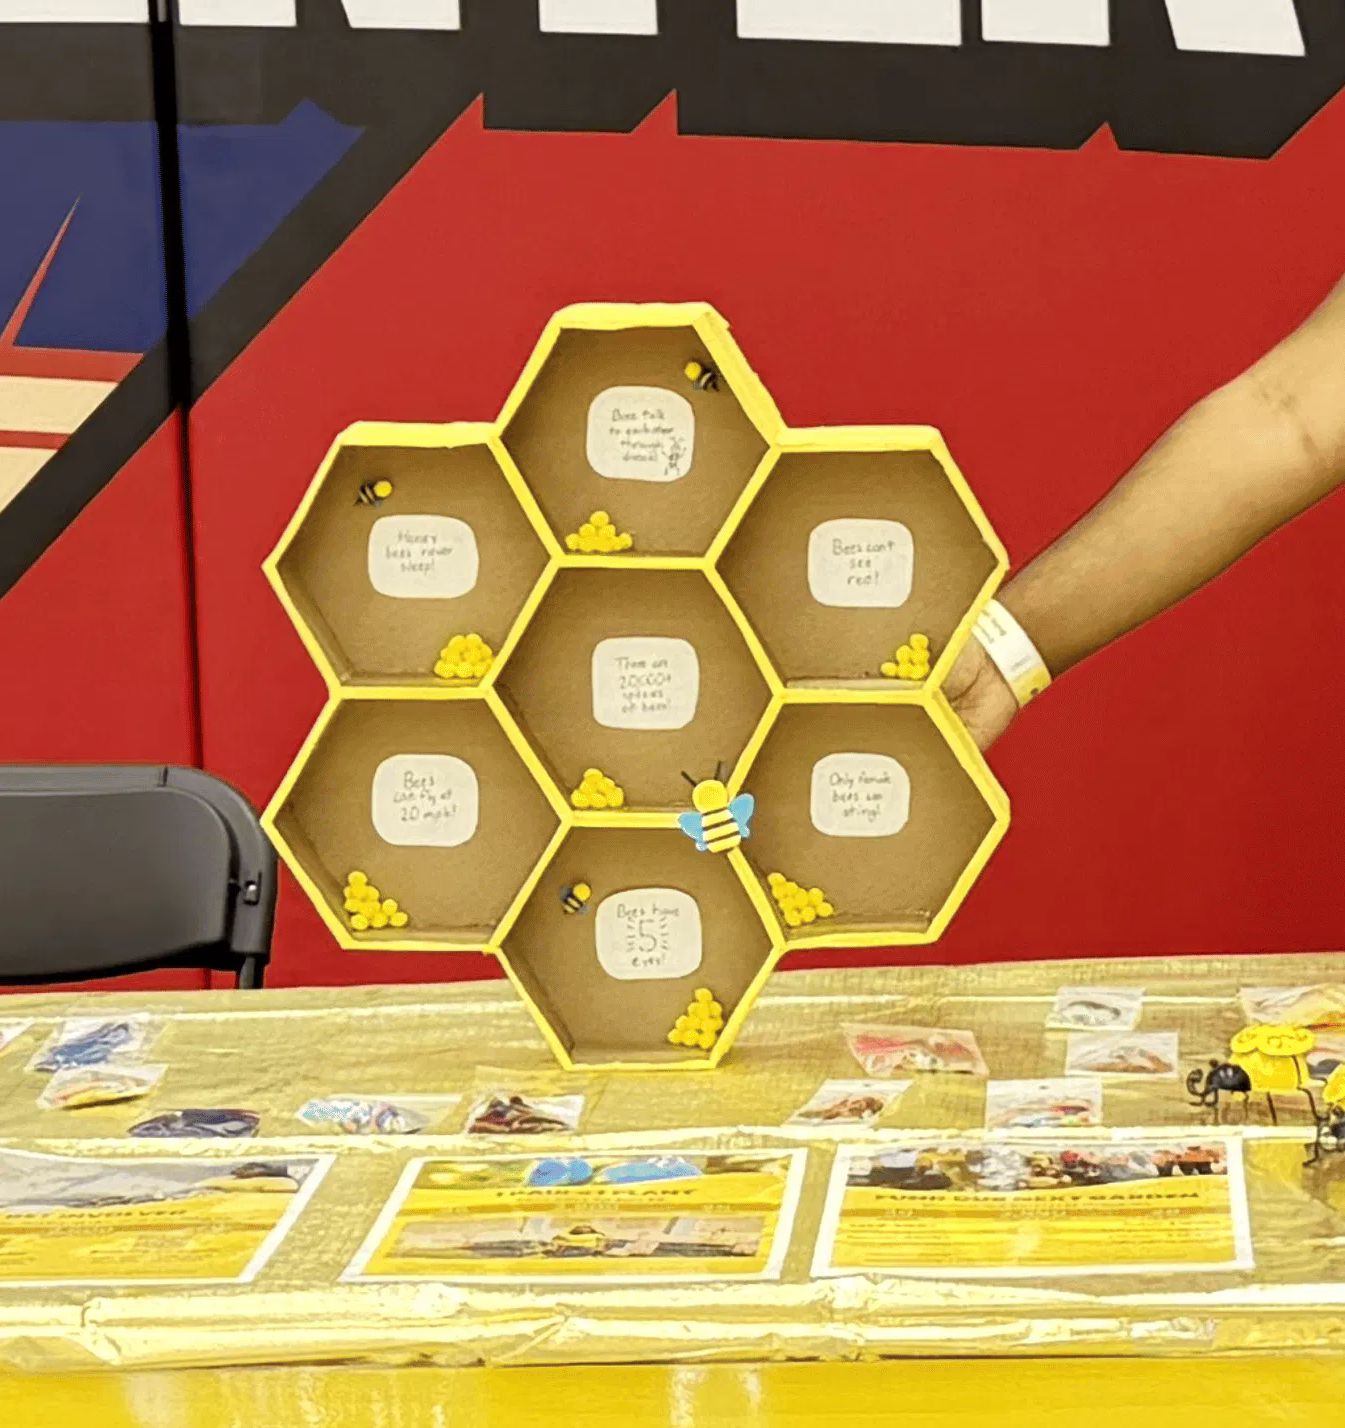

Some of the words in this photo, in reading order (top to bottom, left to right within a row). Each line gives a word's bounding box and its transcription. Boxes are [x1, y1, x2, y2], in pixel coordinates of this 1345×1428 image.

[832, 538, 863, 556] Bees
[849, 559, 871, 569] see
[403, 770, 435, 790] Bees
[617, 903, 645, 918] Bees
[639, 918, 657, 952] 5
